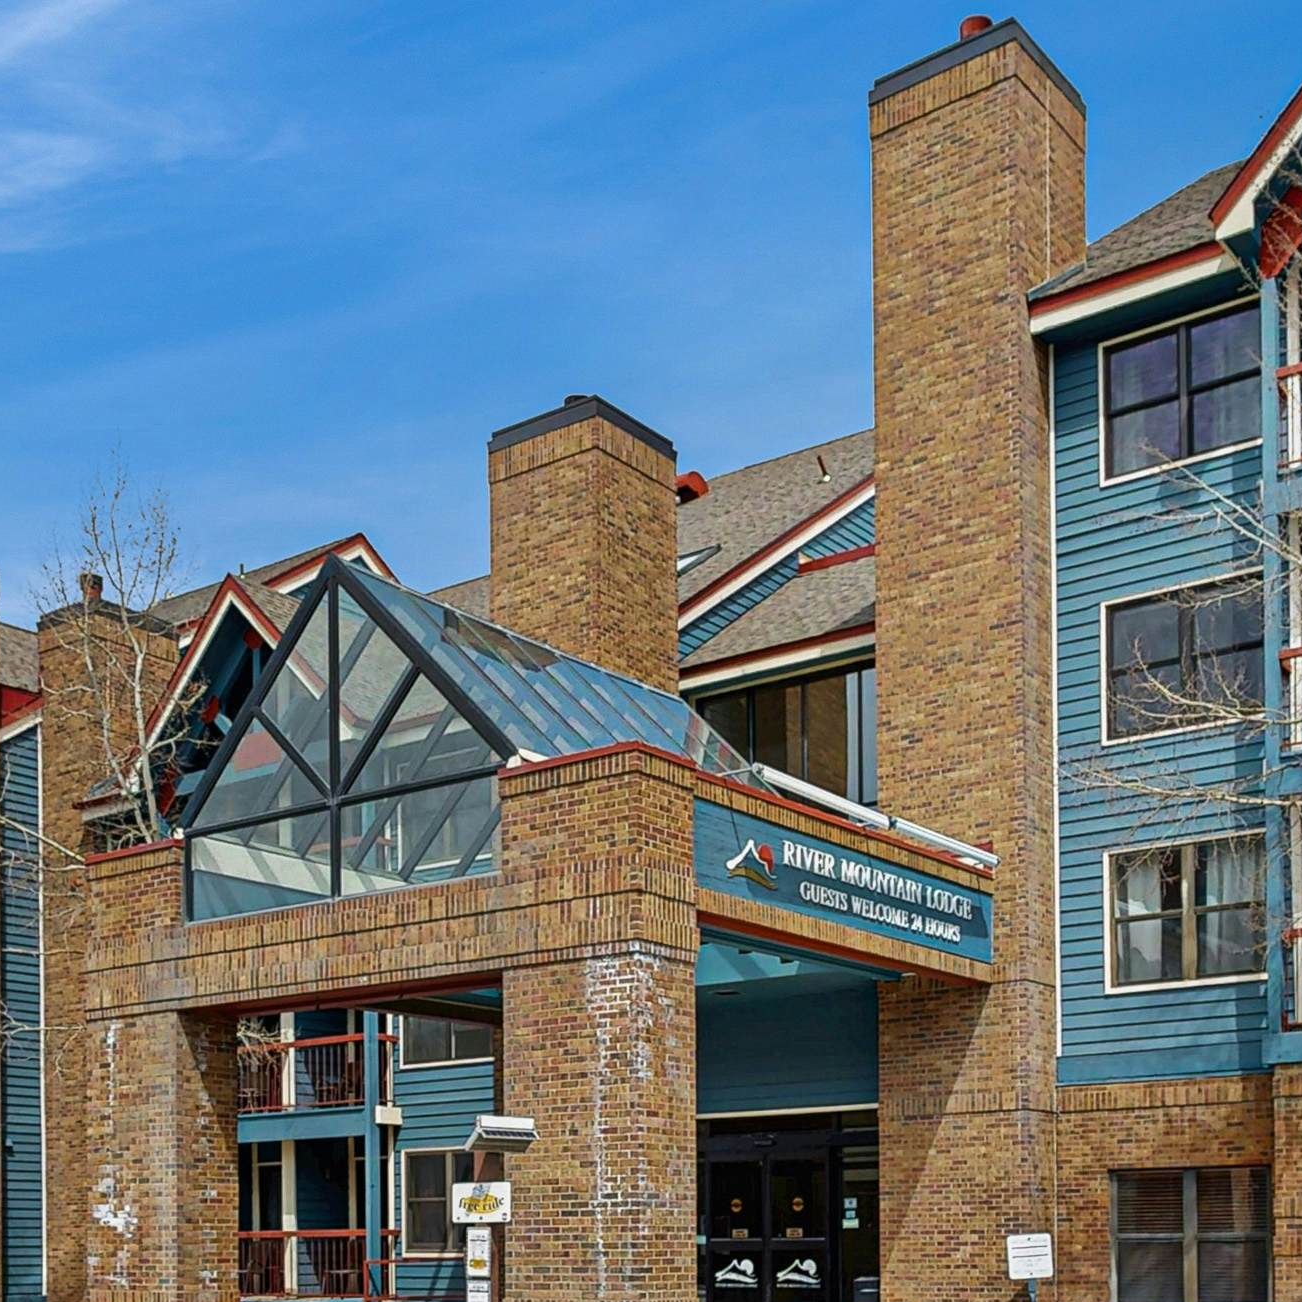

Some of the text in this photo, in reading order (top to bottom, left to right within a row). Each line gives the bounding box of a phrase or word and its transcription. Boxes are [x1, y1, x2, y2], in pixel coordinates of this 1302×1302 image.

[782, 840, 972, 920] RIVER MOUNTAIN LODGE
[799, 881, 961, 942] GUESTS WELCOME 24 HOURS
